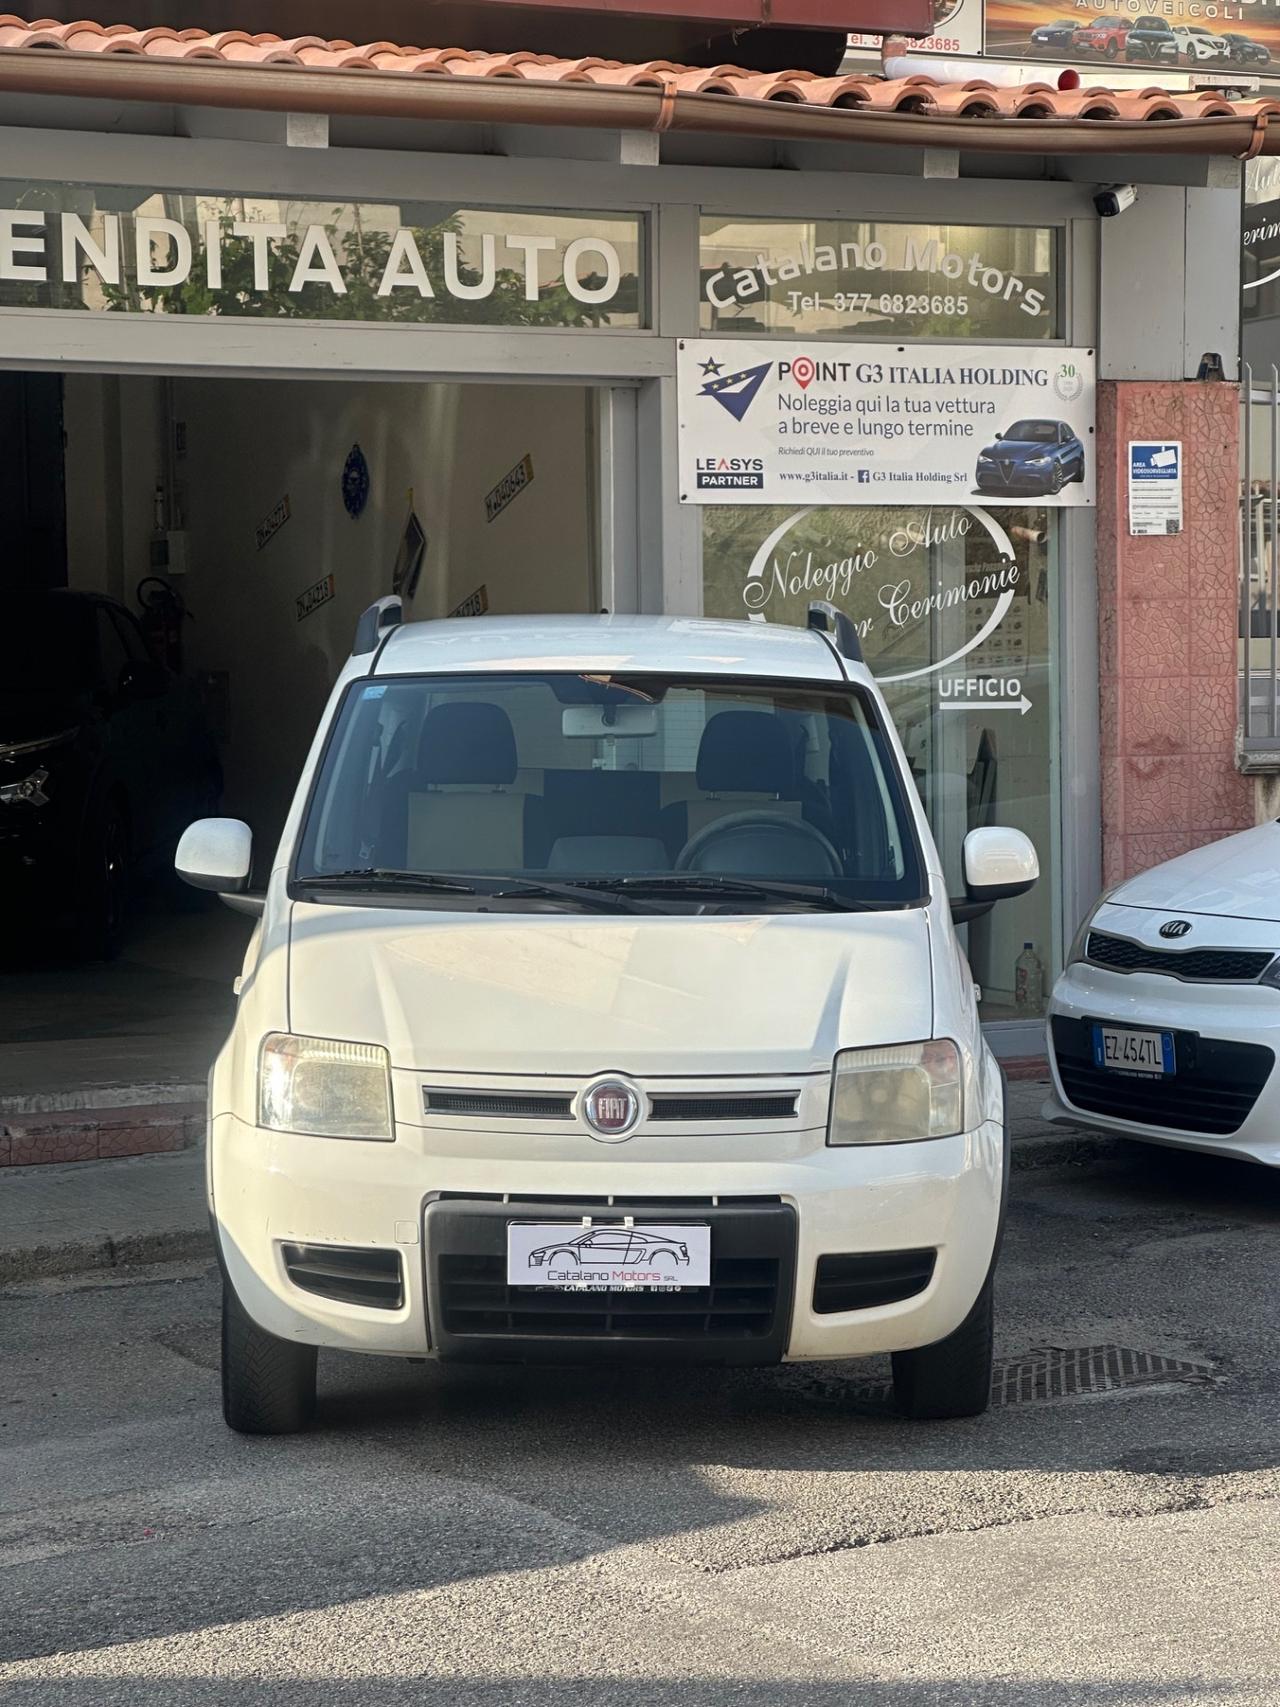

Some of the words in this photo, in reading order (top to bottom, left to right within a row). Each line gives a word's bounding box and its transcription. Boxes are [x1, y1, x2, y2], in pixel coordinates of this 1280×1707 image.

[1075, 0, 1244, 21] AUTOVEICOLI
[851, 34, 867, 45] el.
[377, 228, 621, 304] AUTO
[705, 238, 888, 309] Catalano
[904, 235, 1046, 317] Motors
[787, 290, 825, 312] Tel.
[833, 291, 872, 312] 377
[878, 293, 969, 316] 6823685
[778, 357, 851, 390] POINT
[856, 363, 883, 383] G3
[889, 366, 956, 385] ITALIA
[959, 368, 1049, 387] HOLDING
[1059, 364, 1076, 378] 30
[778, 393, 852, 416] Noleggia
[856, 395, 882, 416] qui
[886, 395, 900, 413] la
[904, 396, 932, 414] tua
[936, 397, 996, 414] vettura
[778, 420, 788, 435] a
[792, 417, 840, 436] breve
[843, 421, 854, 436] e
[857, 418, 904, 440] lungo
[908, 420, 974, 437] termine
[778, 446, 805, 456] Richiedi
[805, 447, 821, 456] QUI
[827, 447, 838, 456] tuo
[838, 447, 875, 458] preventivo
[696, 458, 764, 471] LEASYS
[701, 476, 759, 487] PARTNER
[779, 471, 849, 483] www.g3italia.it
[872, 471, 886, 482] G3
[888, 471, 914, 482] Italia
[915, 472, 952, 484] Holding
[955, 472, 968, 483] Srl
[742, 541, 879, 609] Noleggio
[888, 507, 974, 557] Auto
[877, 557, 1022, 628] Cerimonie
[938, 678, 1022, 698] UFFICIO
[1161, 922, 1186, 935] KIA
[1103, 1035, 1119, 1060] EZ
[1123, 1037, 1162, 1065] 454TL
[598, 1097, 628, 1120] FIAT
[547, 1270, 610, 1282] Catalano
[612, 1270, 661, 1282] Motors
